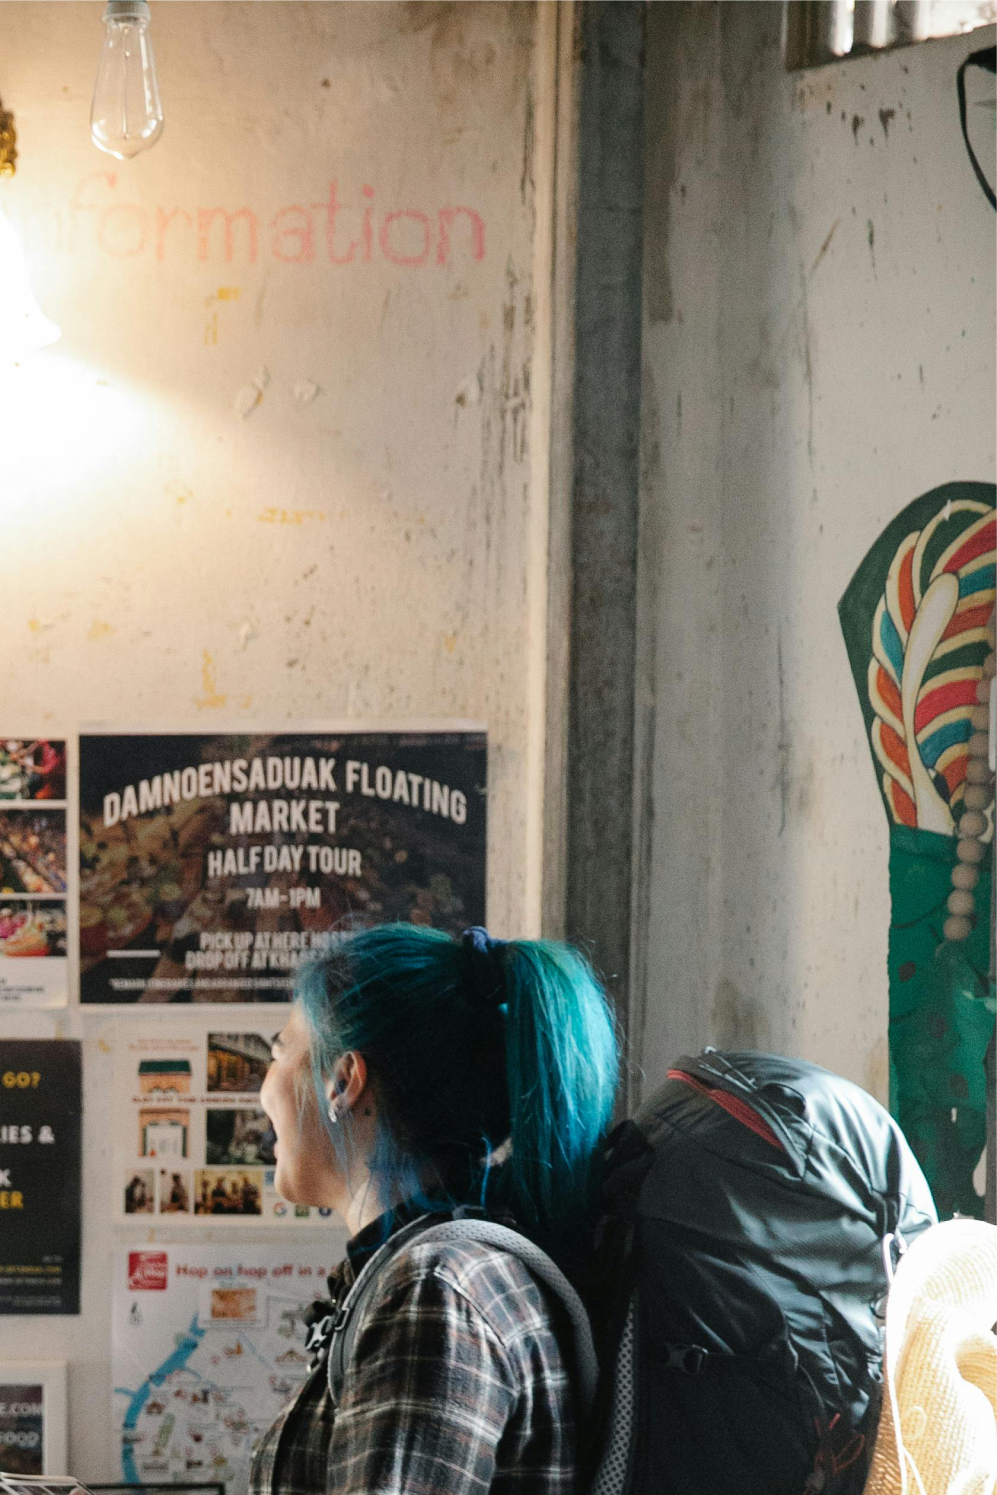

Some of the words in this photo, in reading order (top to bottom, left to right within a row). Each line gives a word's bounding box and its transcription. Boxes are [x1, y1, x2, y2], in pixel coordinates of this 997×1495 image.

[103, 756, 337, 828] DAMNOENSADUAK
[345, 759, 467, 825] FLOATING
[229, 799, 340, 835] MARKET
[207, 846, 261, 877] HALF
[263, 844, 304, 874] DAY
[306, 845, 362, 877] TOUR
[199, 931, 233, 951] PICK
[234, 931, 253, 950] UP
[255, 931, 269, 950] AT
[271, 931, 308, 950] HERE
[185, 950, 223, 971] DROP
[224, 950, 251, 971] OFF
[3, 1071, 42, 1088] GO?
[38, 1125, 56, 1144] &
[176, 1263, 208, 1279] Hop
[213, 1266, 233, 1277] on
[237, 1263, 268, 1279] hop
[271, 1263, 294, 1278] off
